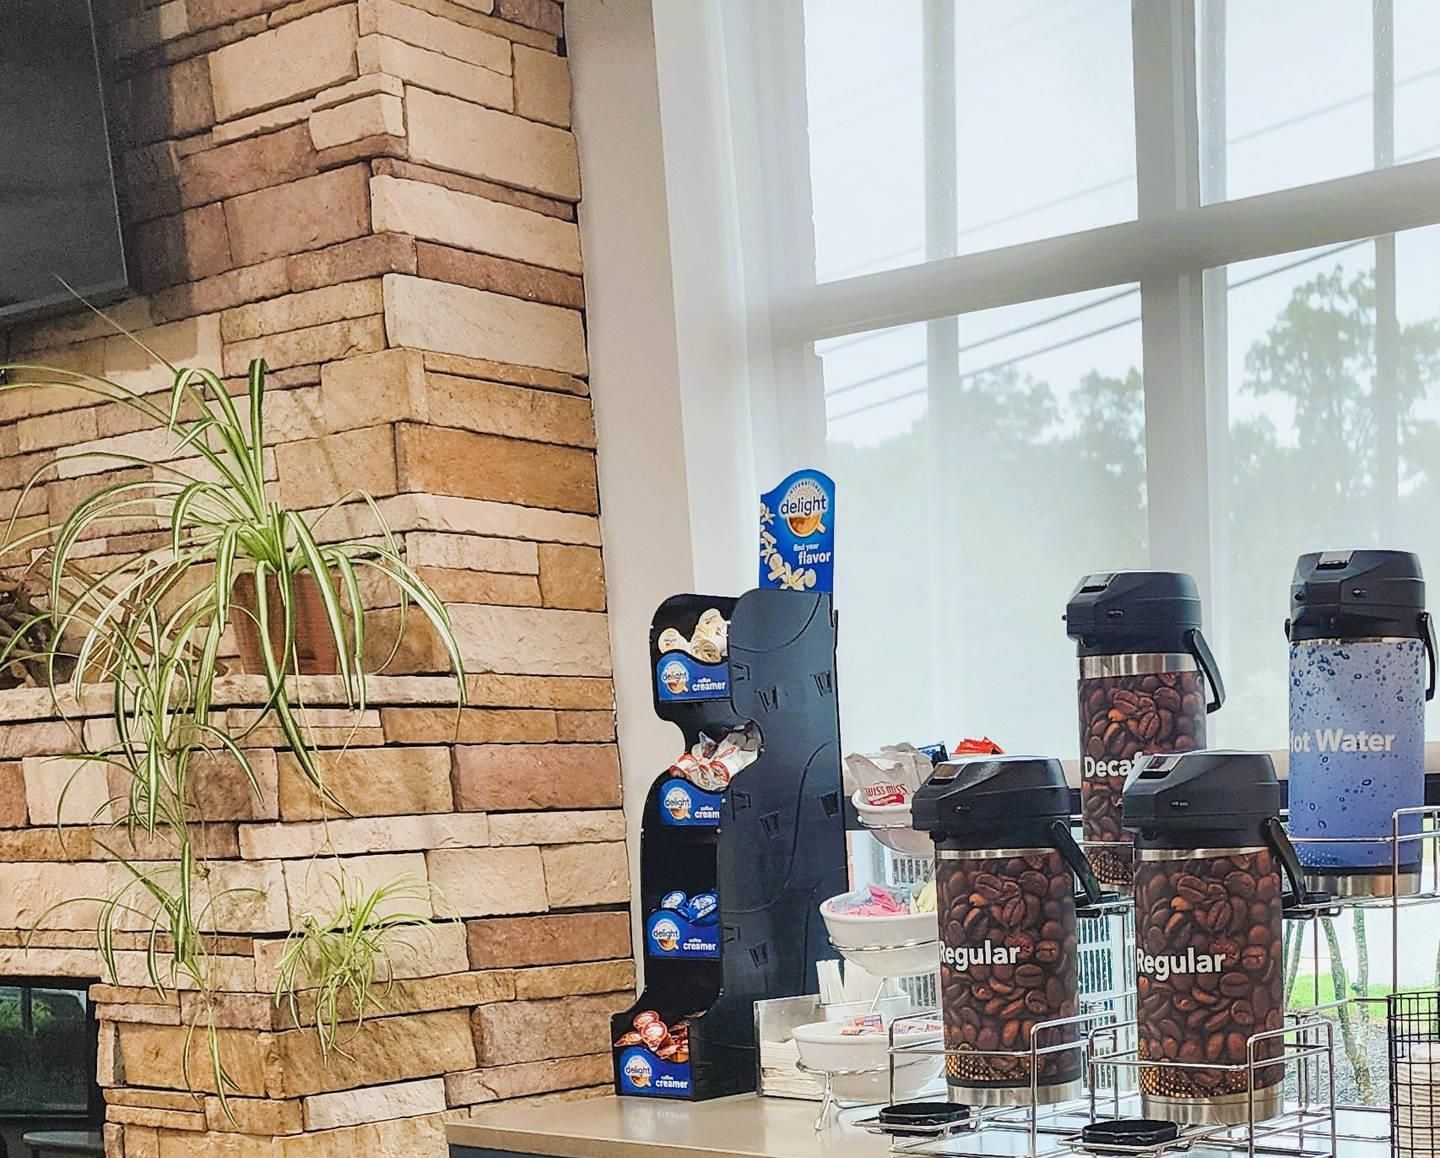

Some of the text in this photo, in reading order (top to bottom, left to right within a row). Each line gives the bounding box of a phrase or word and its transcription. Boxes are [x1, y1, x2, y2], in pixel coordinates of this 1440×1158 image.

[781, 495, 827, 516] delight
[798, 550, 832, 565] flavor
[692, 682, 726, 691] creamer
[1315, 728, 1395, 752] Water
[665, 798, 690, 808] delight
[694, 810, 720, 819] cream
[653, 928, 679, 939] delight
[683, 942, 717, 951] creamer
[940, 939, 1020, 971] Regular
[1136, 947, 1226, 981] Regular
[626, 1066, 651, 1076] delight
[655, 1080, 689, 1089] creamer
